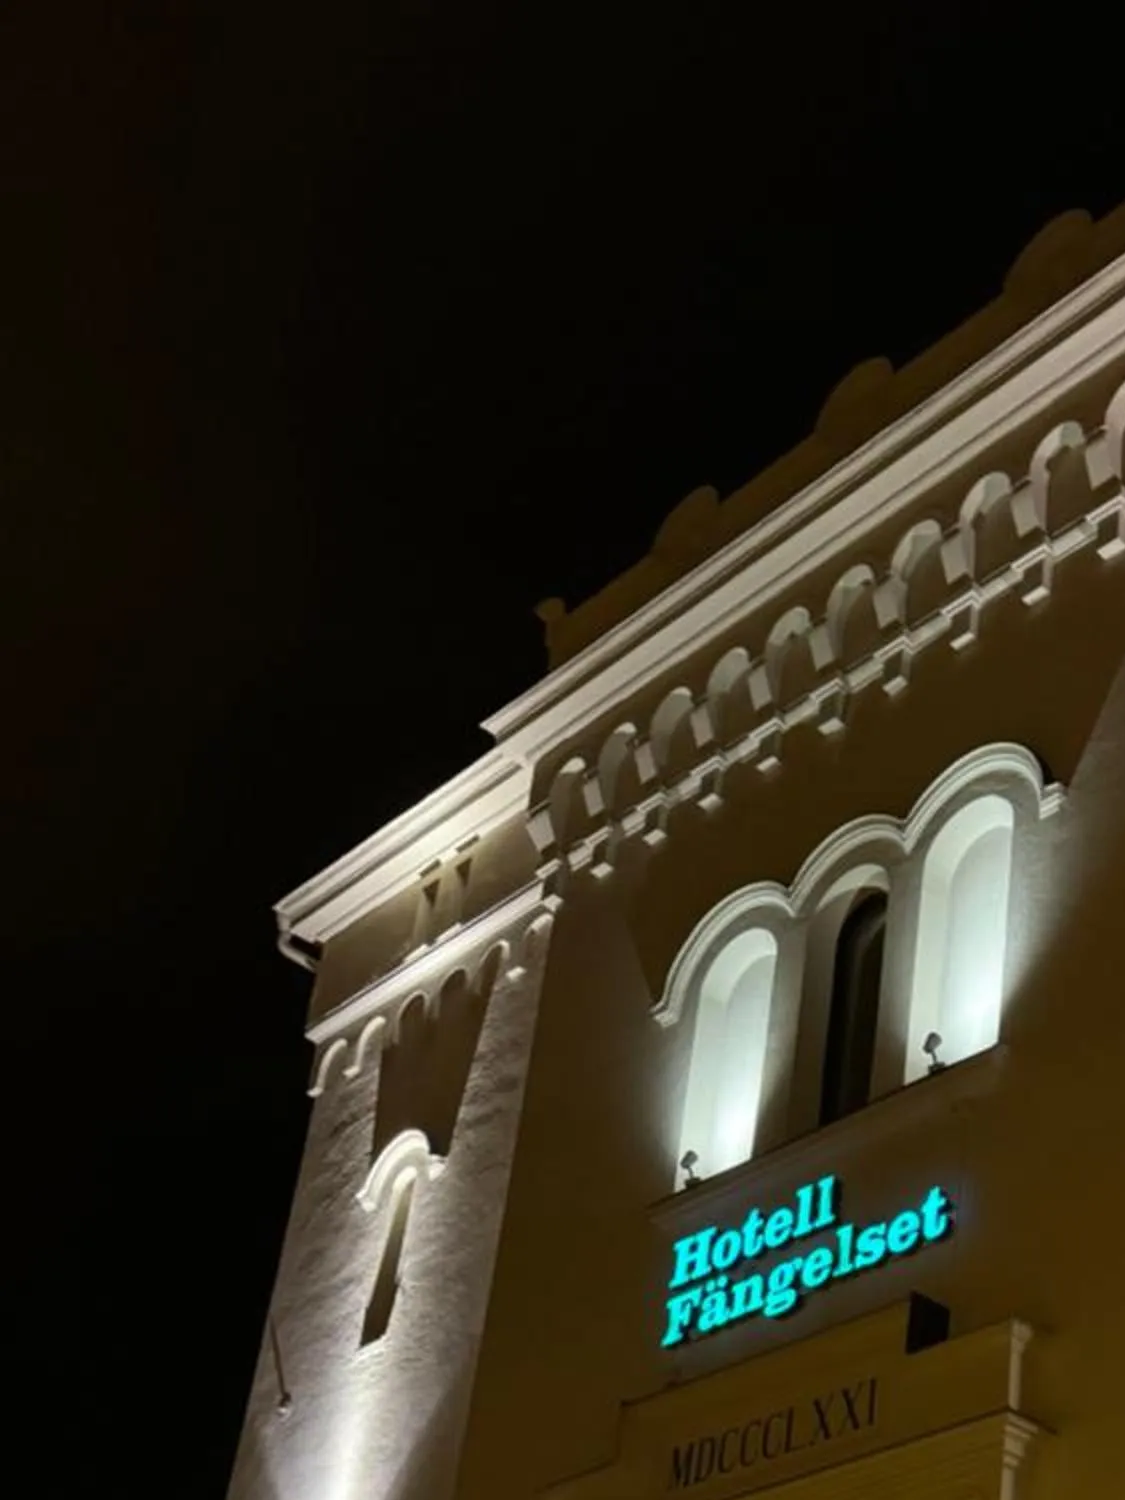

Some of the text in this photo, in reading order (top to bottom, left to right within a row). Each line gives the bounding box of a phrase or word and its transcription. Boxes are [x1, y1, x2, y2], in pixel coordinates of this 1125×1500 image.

[660, 1186, 951, 1348] Fängelset
[669, 1175, 837, 1289] Hotell
[670, 1378, 877, 1489] MDCCCLXXI
